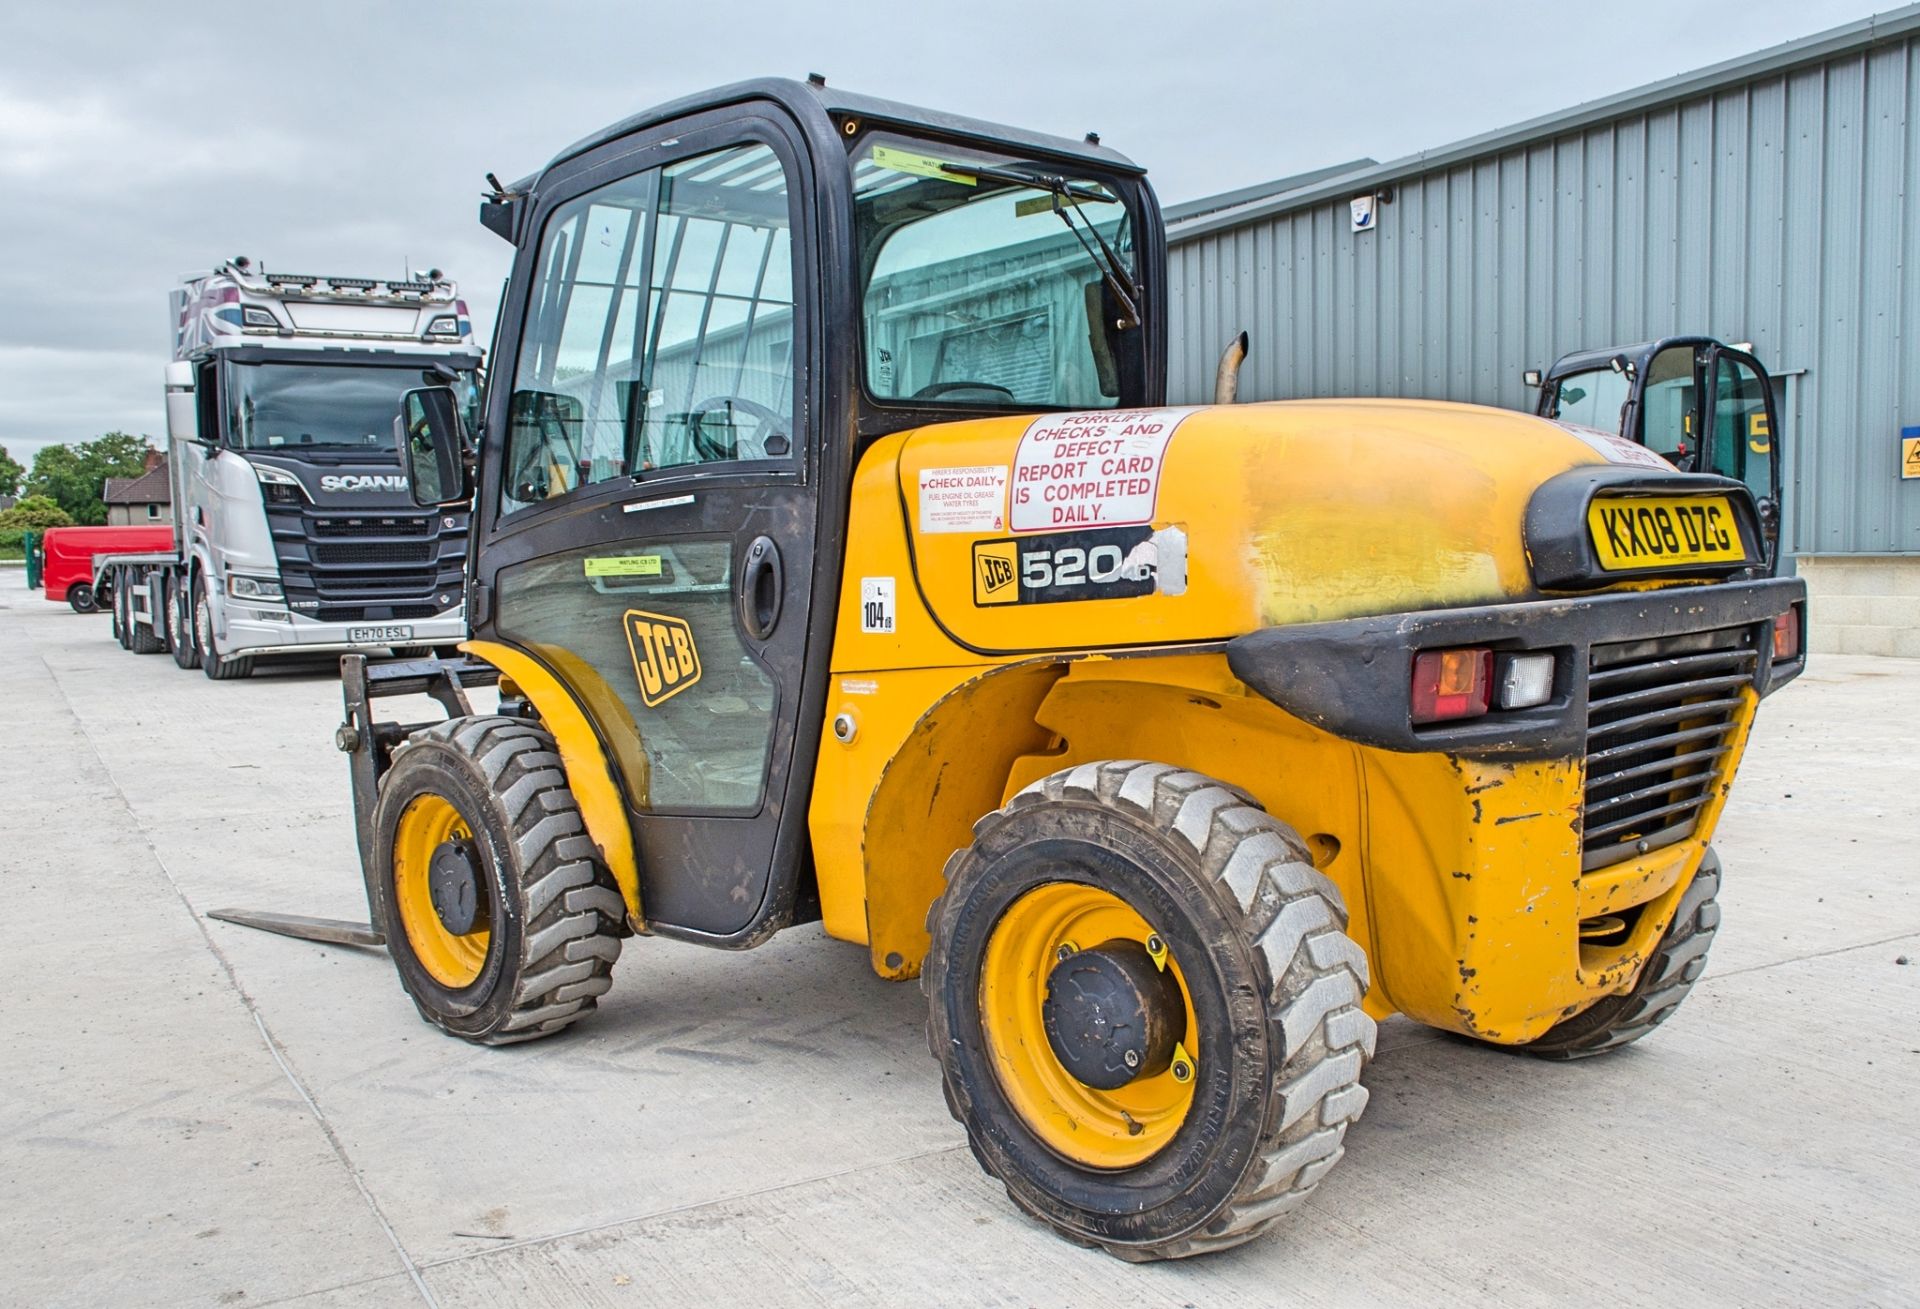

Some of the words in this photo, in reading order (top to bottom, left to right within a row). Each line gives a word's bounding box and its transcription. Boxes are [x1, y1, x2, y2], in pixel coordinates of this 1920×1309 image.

[1063, 414, 1152, 425] FORKLIFT
[1034, 426, 1107, 442] CHECKS
[1120, 424, 1163, 436] AND
[1749, 413, 1770, 453] 5
[1054, 440, 1124, 458] DEFECT
[1018, 461, 1087, 482] REPORT
[1101, 457, 1154, 476] CARD
[928, 477, 963, 488] CHECK
[966, 476, 996, 487] DAILY
[1015, 487, 1030, 504] IS
[1044, 478, 1150, 502] COMPLETED
[1053, 503, 1106, 523] DAILY.
[1600, 507, 1680, 558] KX08
[1674, 506, 1731, 552] DZG
[985, 559, 1013, 589] JCB
[877, 586, 883, 596] L
[864, 602, 884, 628] 104
[354, 627, 384, 640] EH70
[386, 627, 407, 639] ESL
[634, 620, 695, 695] JCB
